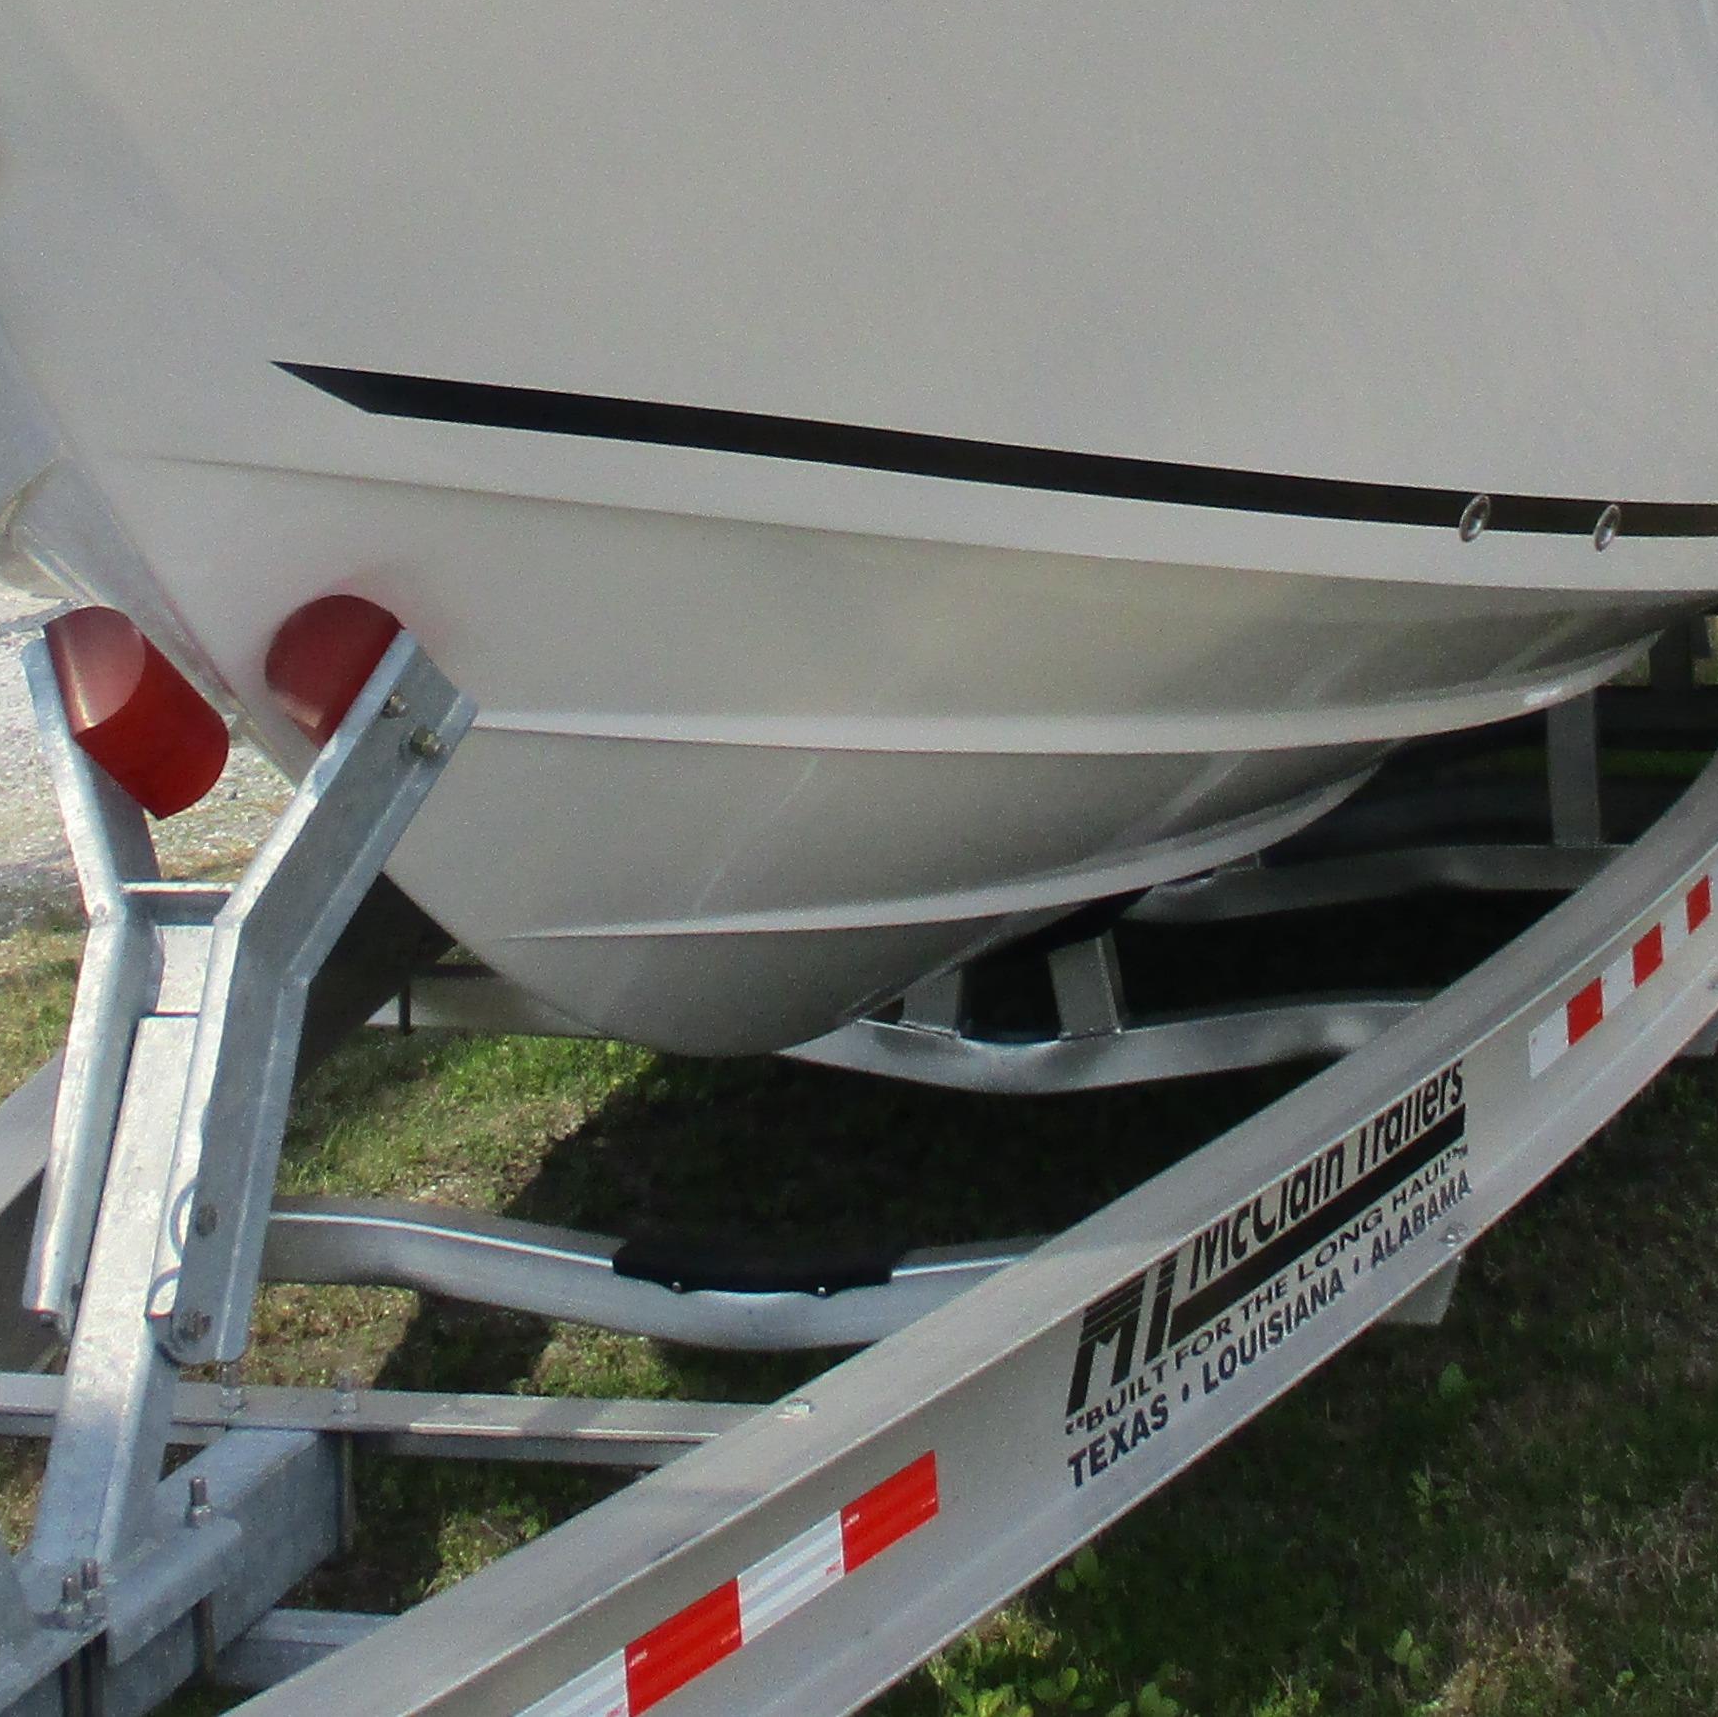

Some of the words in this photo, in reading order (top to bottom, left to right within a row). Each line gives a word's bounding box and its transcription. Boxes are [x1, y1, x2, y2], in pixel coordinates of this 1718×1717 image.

[1067, 1393, 1169, 1488] TEXAS
[1202, 1267, 1346, 1395] LOUISIANA
[1370, 1168, 1473, 1269] ALABAMA
[1174, 1316, 1234, 1372] FOR
[1239, 1274, 1289, 1323] THE
[1297, 1206, 1383, 1283] LONG
